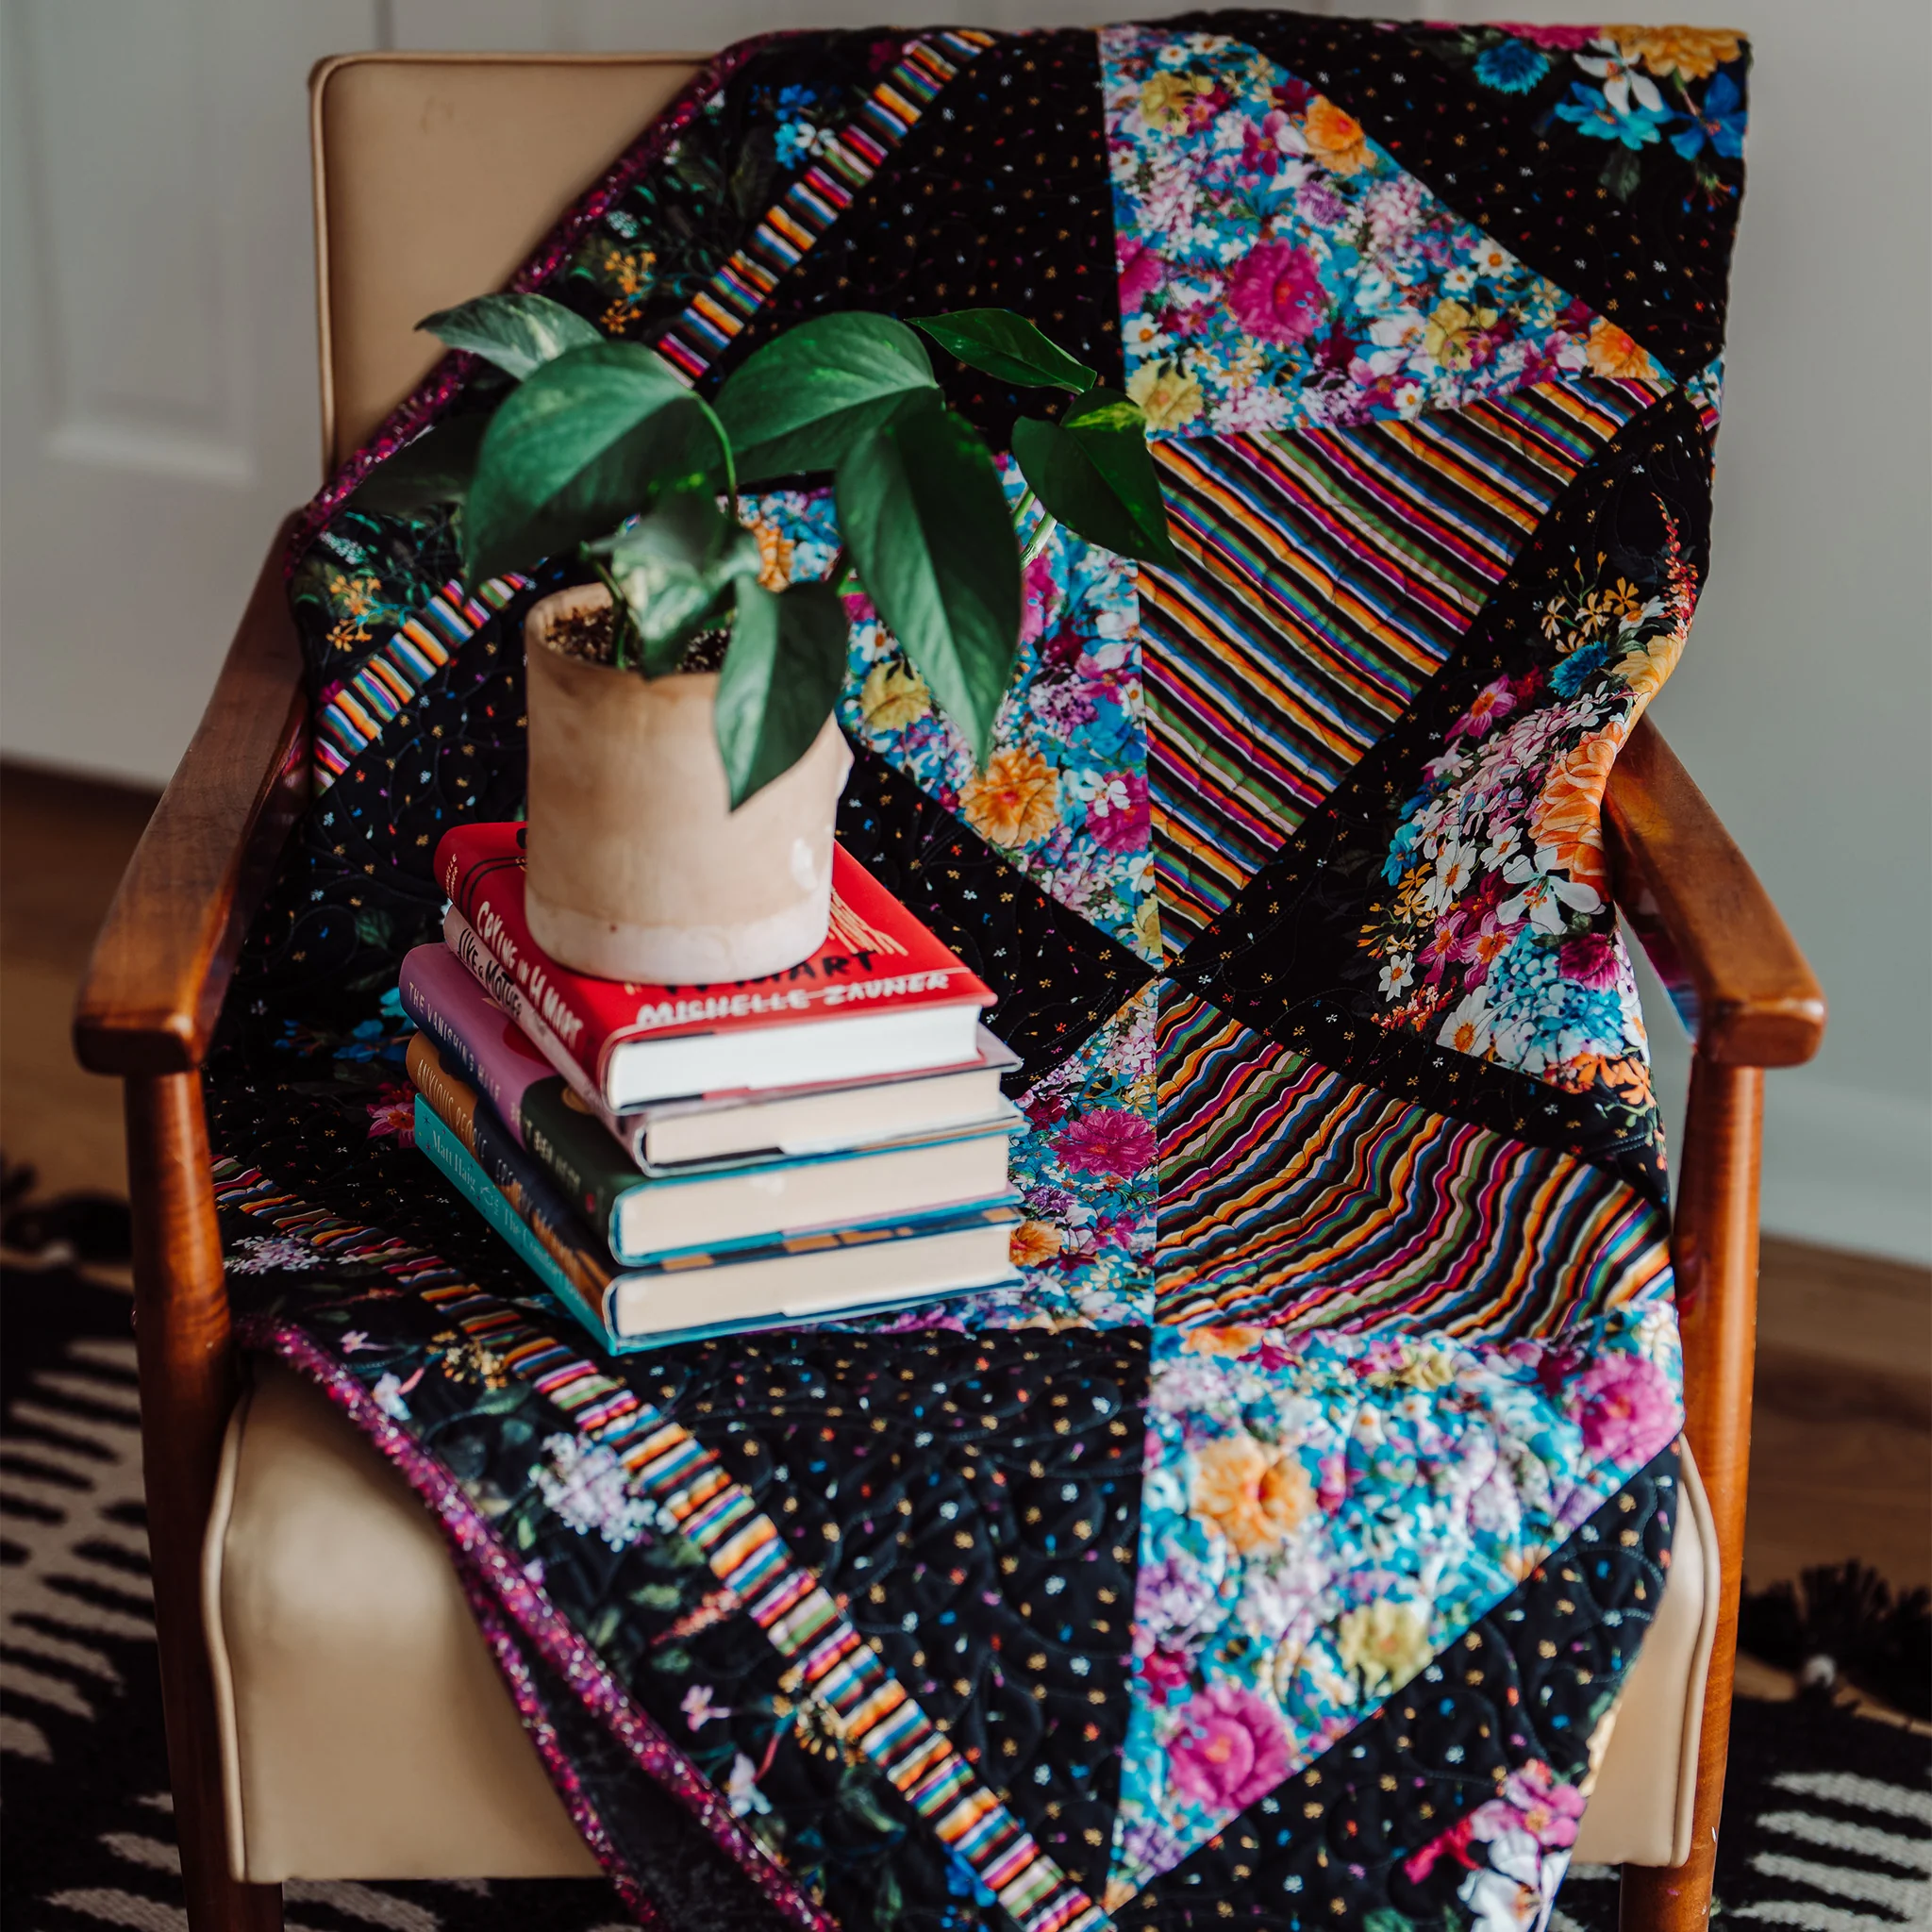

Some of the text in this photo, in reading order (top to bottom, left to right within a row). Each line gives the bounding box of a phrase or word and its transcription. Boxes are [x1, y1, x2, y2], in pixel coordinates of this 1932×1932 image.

[476, 901, 518, 970] CRYING
[824, 973, 949, 1007] ZAUNER
[408, 981, 425, 1014] THE
[427, 1003, 475, 1072] VANISHING
[416, 1058, 454, 1126] ANXIOUS
[433, 1130, 475, 1192] Matt Haig
